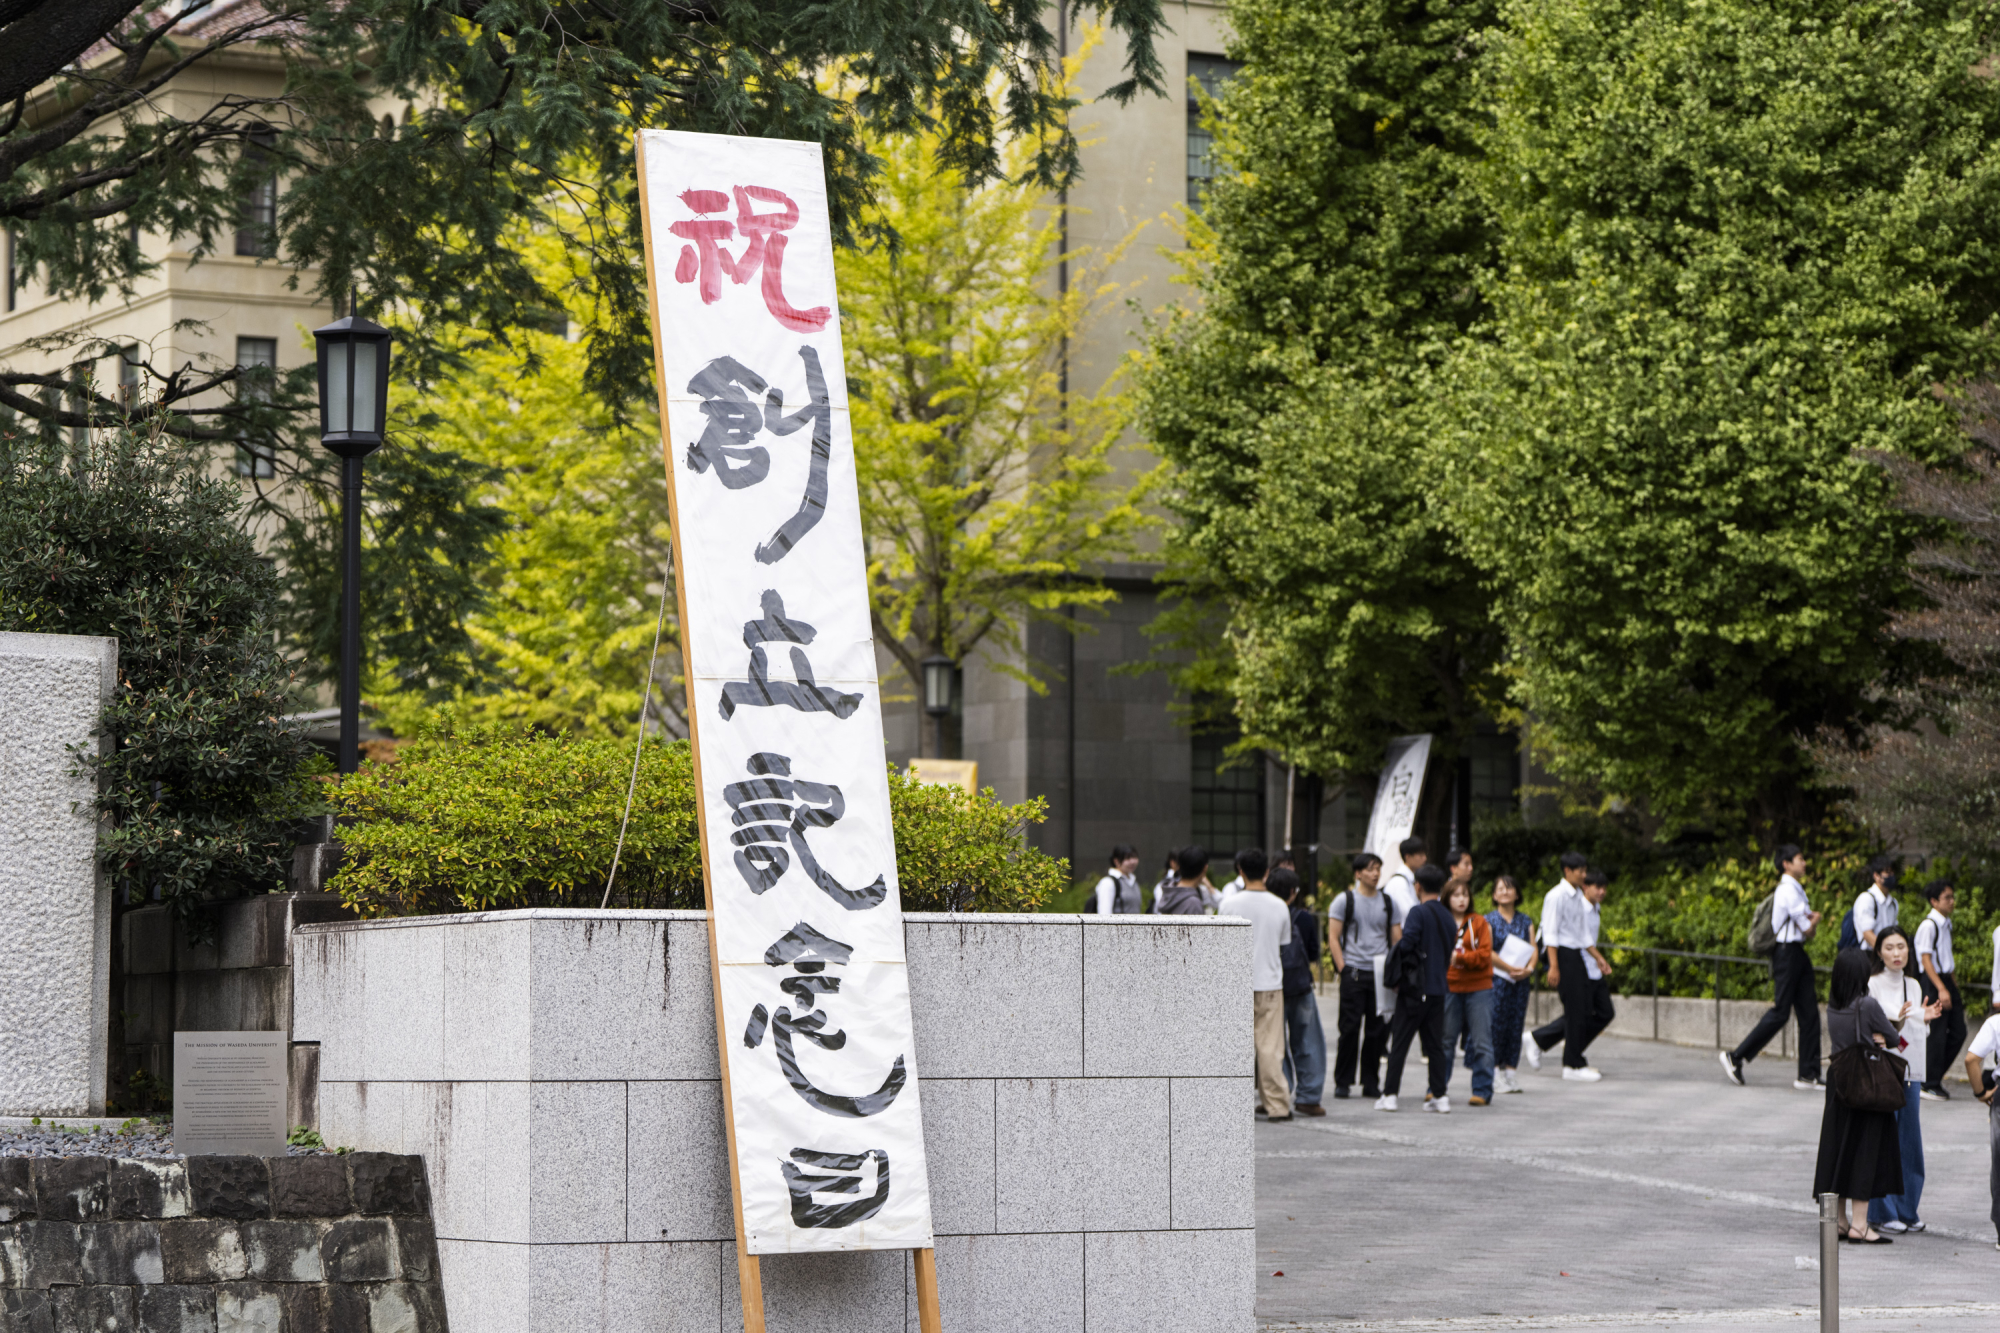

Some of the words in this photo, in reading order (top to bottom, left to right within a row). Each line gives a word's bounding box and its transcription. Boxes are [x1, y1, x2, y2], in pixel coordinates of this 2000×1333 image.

[667, 184, 907, 1229] 祝創立記念日
